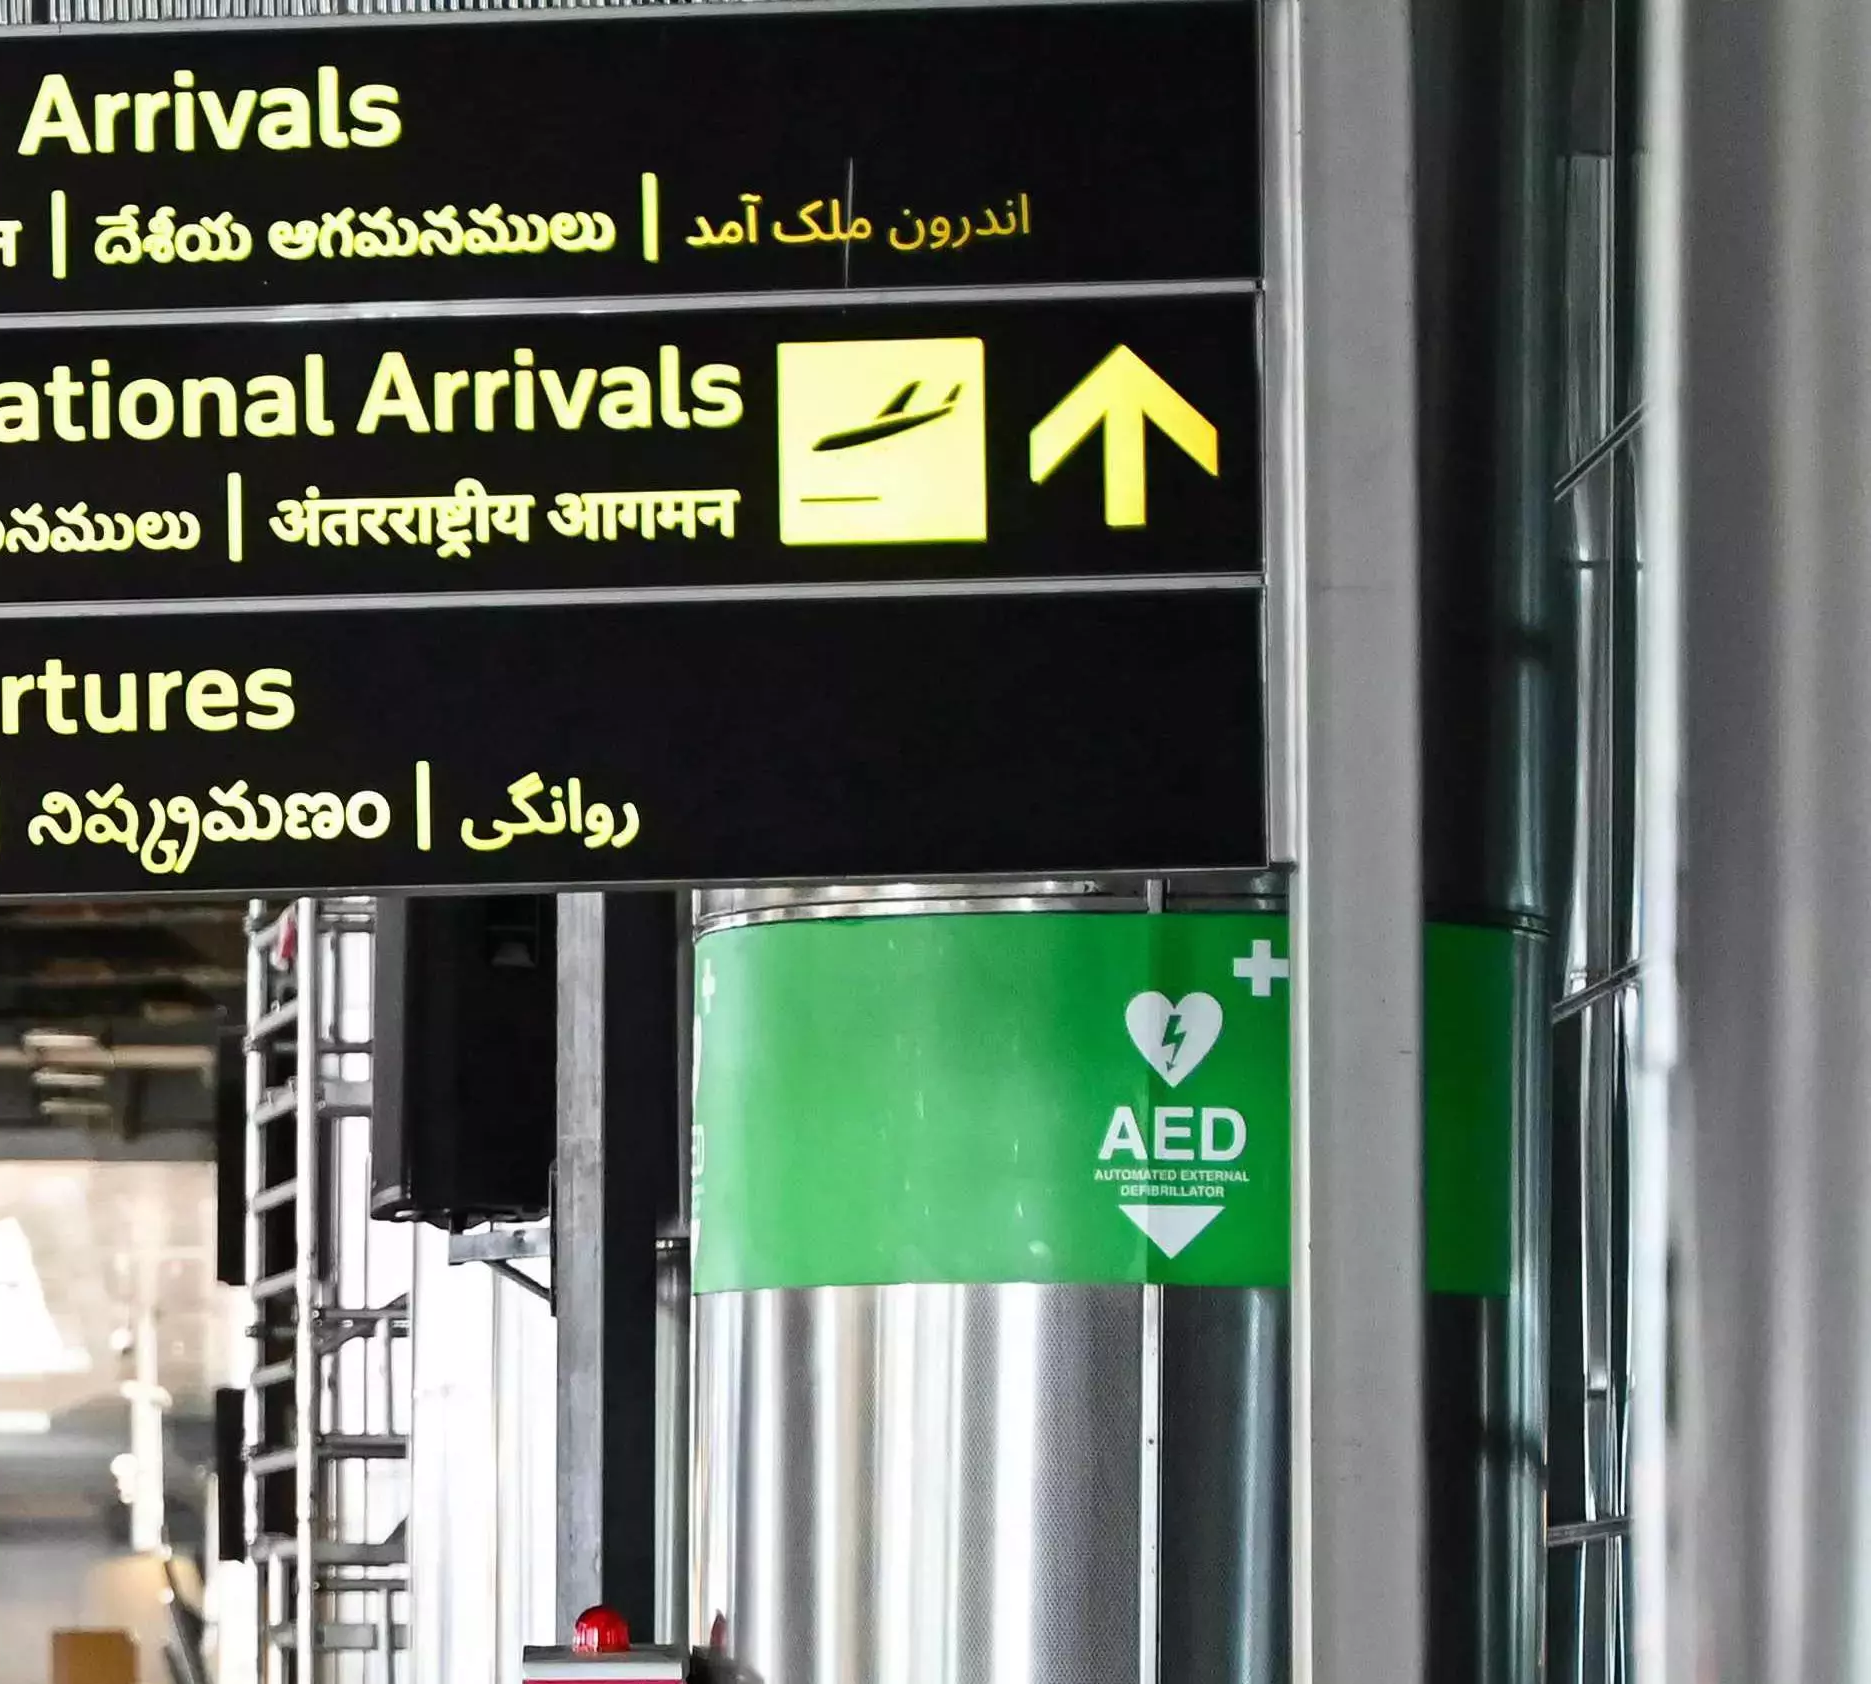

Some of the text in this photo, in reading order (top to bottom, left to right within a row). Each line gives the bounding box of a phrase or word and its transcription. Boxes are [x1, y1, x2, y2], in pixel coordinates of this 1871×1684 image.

[17, 65, 402, 156] Arrivals
[94, 202, 617, 265] దేశీయ ఆగమనములు
[685, 192, 1031, 251] اندرون ملک آمد
[356, 344, 745, 434] Arrivals
[268, 477, 742, 559] अंतरराष्ट्रीय आगमन
[460, 771, 640, 851] روانگی
[1097, 1105, 1248, 1162] AED
[1094, 1168, 1251, 1182] AUTOMATED EXTERNAL
[1119, 1184, 1225, 1198] DEFIBRILLATOR
